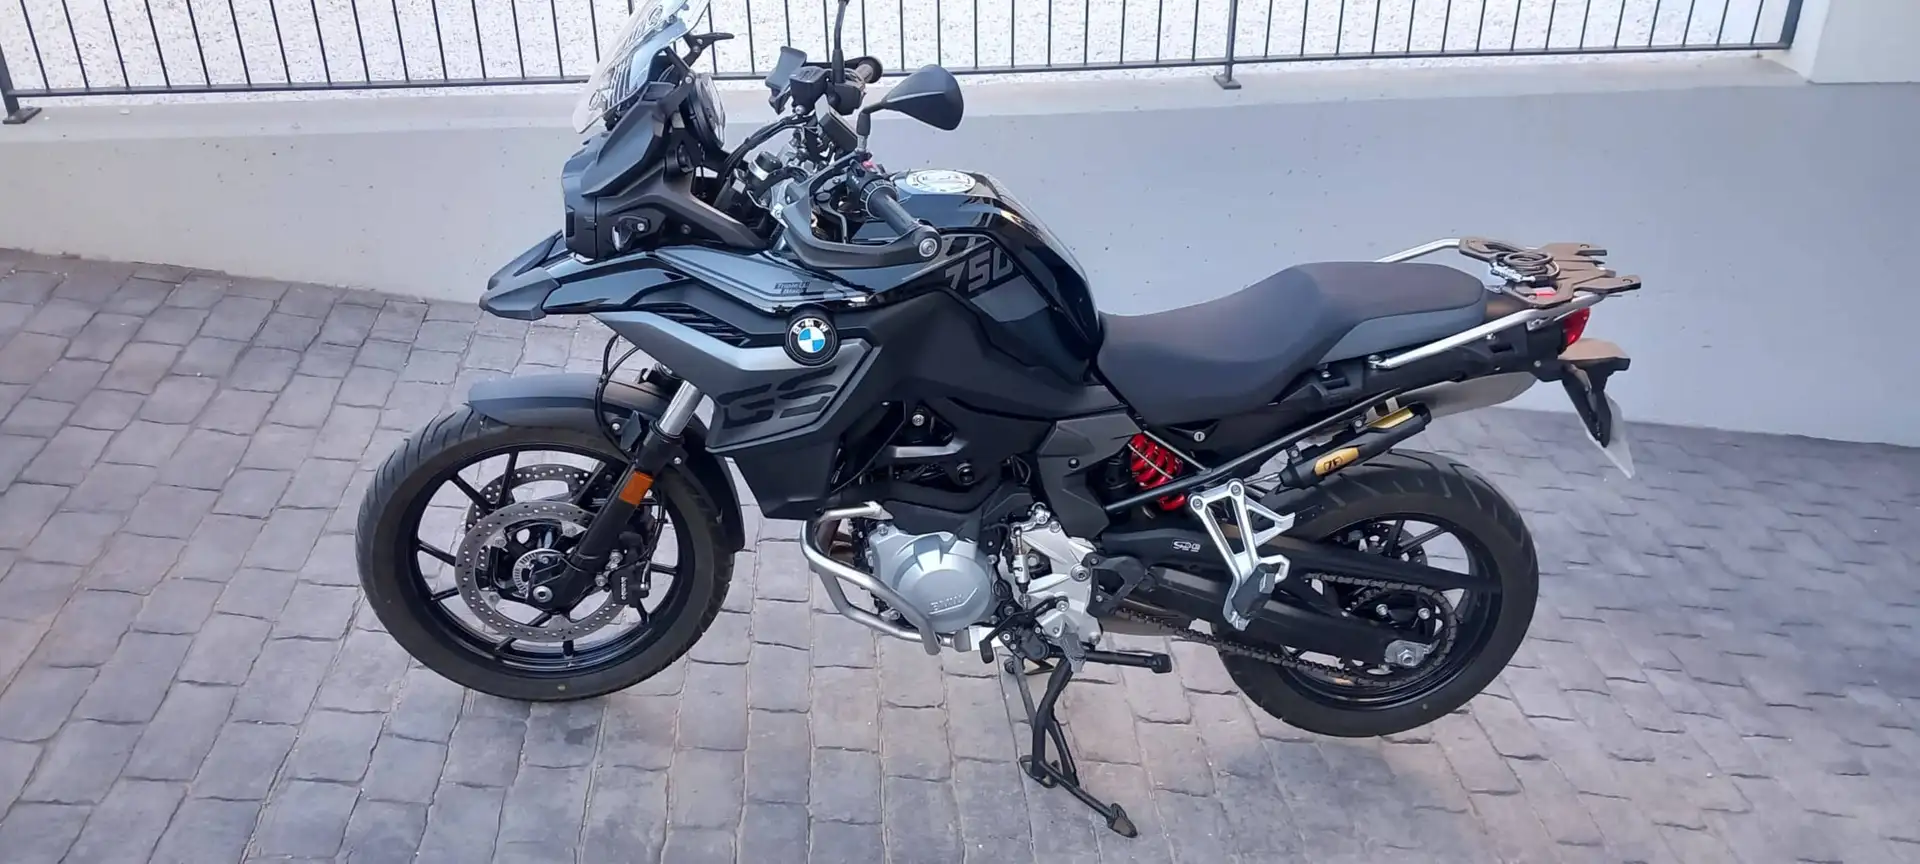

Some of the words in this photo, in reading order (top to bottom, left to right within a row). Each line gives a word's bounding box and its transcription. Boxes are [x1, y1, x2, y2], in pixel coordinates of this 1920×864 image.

[945, 247, 1014, 292] 750
[792, 318, 829, 335] BMW
[716, 365, 838, 429] GS
